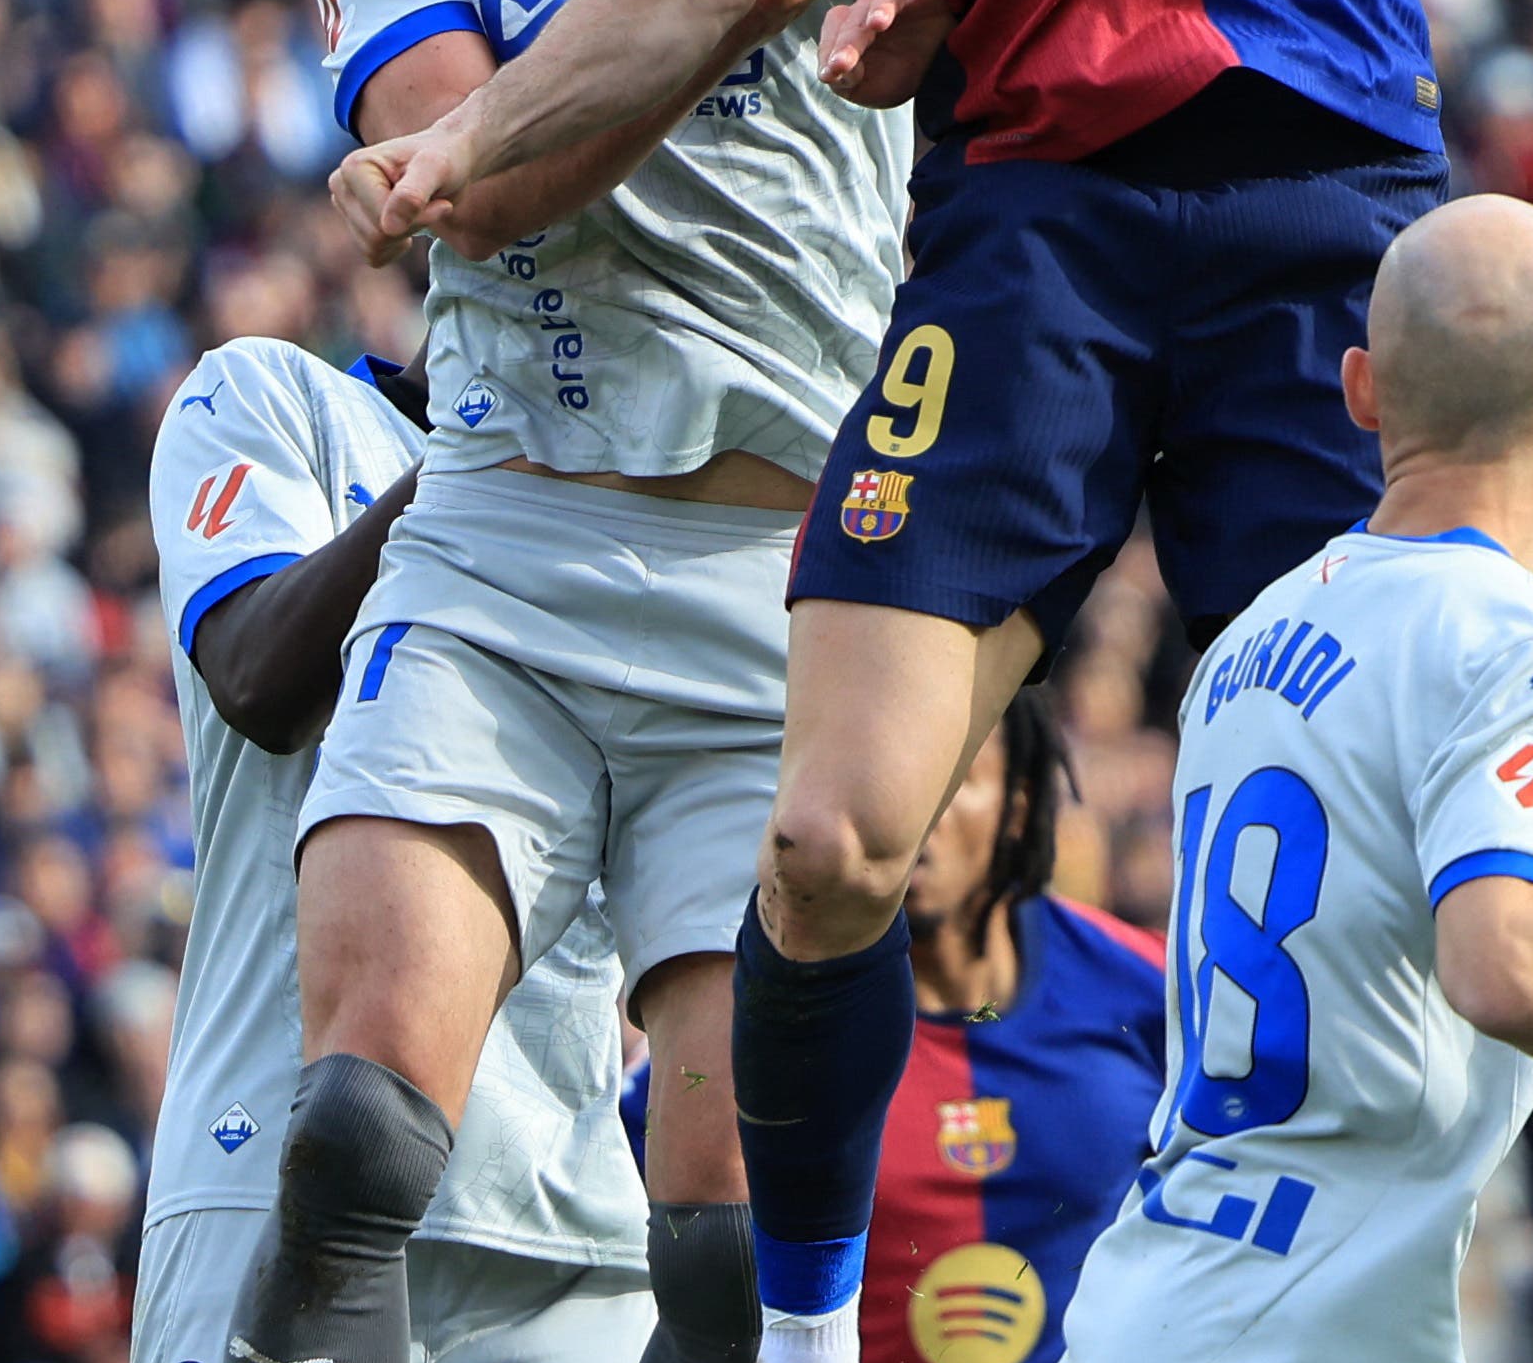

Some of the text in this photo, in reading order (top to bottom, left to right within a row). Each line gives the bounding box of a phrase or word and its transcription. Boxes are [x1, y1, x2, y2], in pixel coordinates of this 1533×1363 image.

[688, 92, 762, 118] EWS
[867, 324, 955, 458] 9
[859, 498, 887, 511] FCB
[1205, 618, 1356, 726] GURIDI
[1157, 766, 1329, 1152] 18
